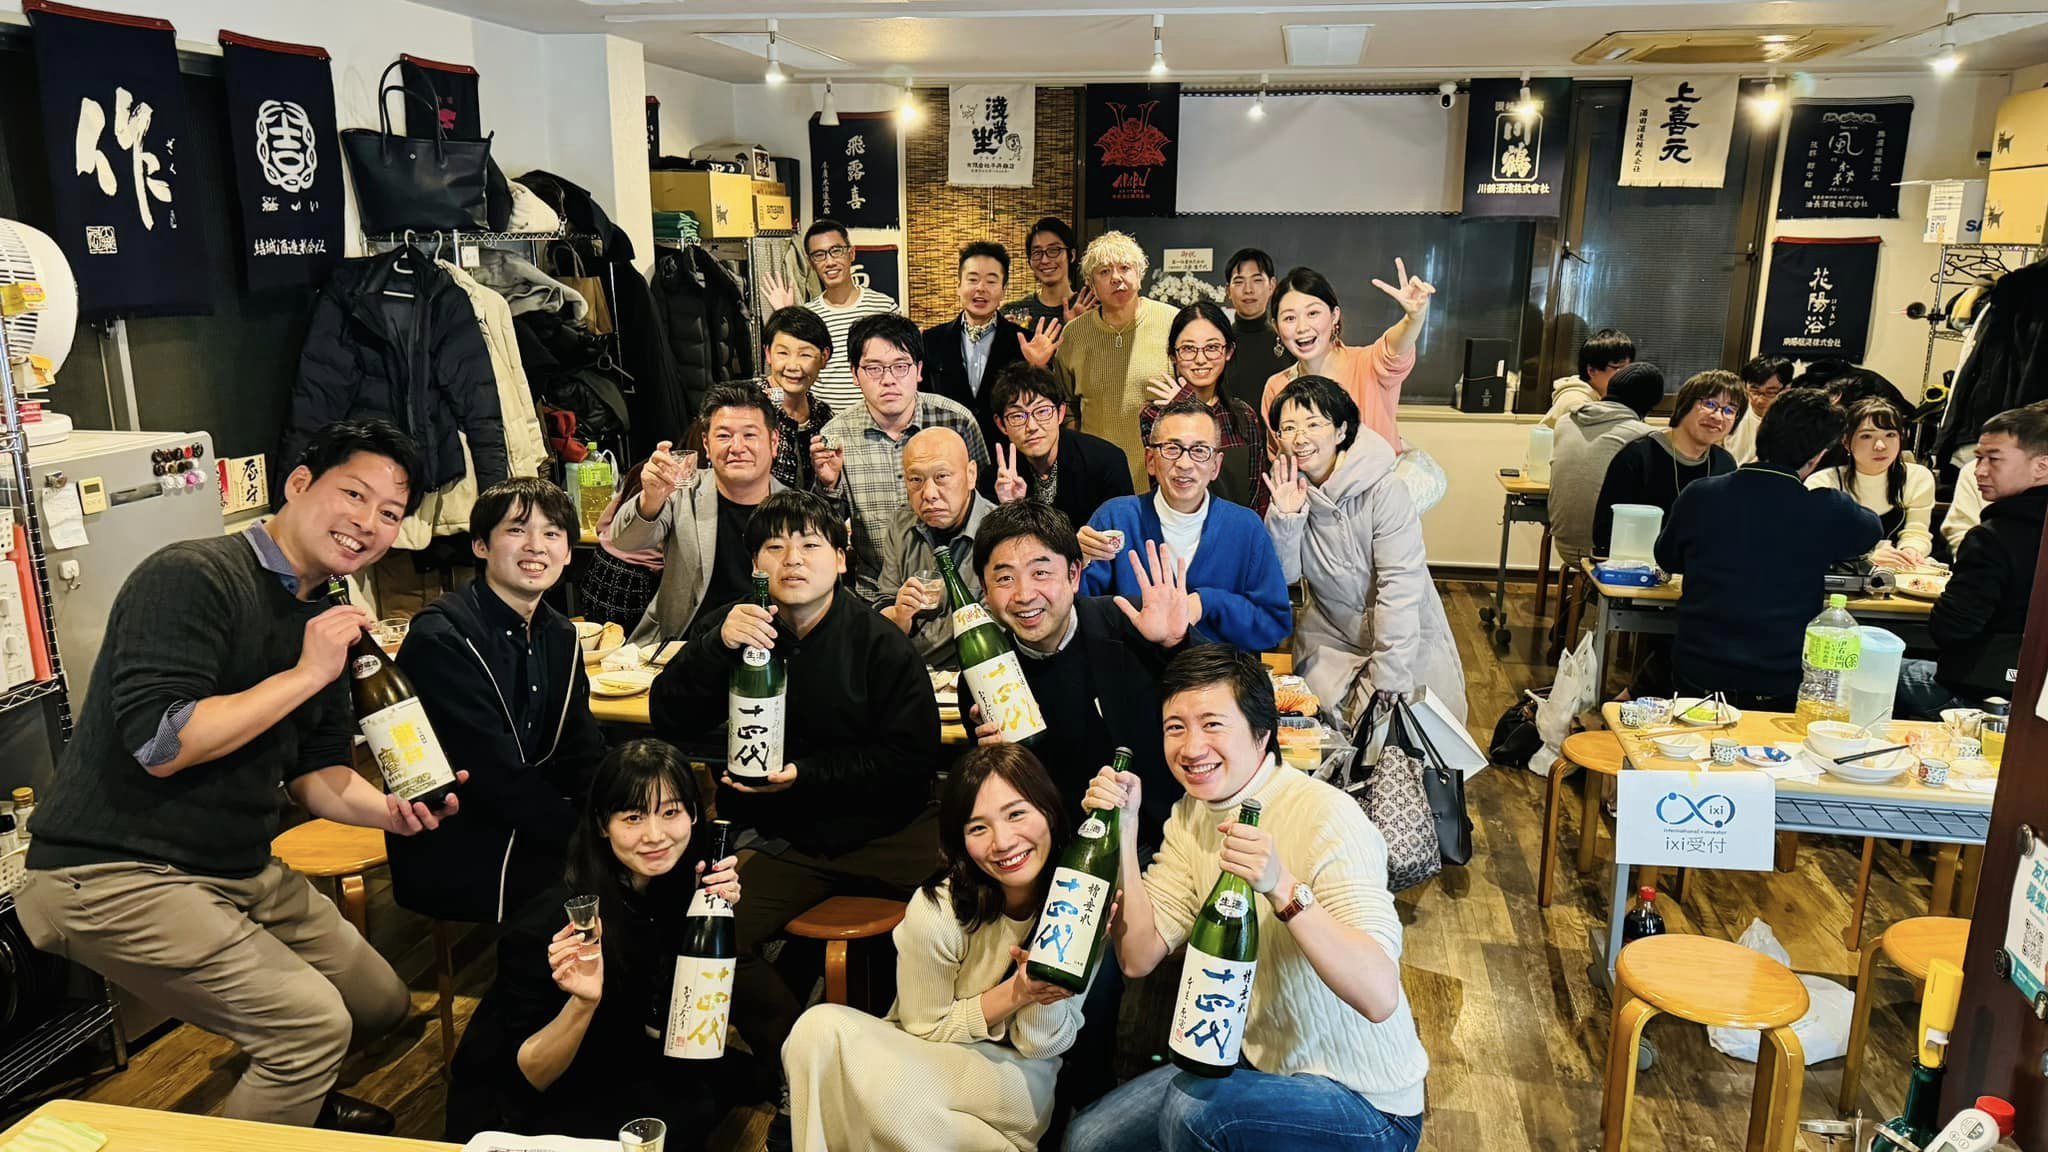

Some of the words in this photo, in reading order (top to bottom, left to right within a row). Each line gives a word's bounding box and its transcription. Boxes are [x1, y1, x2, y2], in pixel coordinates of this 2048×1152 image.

[1659, 81, 1702, 164] 上喜元
[76, 86, 172, 231] 作
[845, 134, 867, 211] 飛露喜
[1804, 267, 1833, 336] 花陽浴
[746, 650, 766, 660] 生酒
[983, 662, 1037, 731] 十四代
[734, 704, 768, 772] 十四代
[1709, 805, 1724, 815] ixi
[1666, 836, 1728, 854] ixi受付
[1035, 878, 1080, 962] 十四代
[1080, 883, 1101, 926] 槽垂れ
[688, 966, 729, 1051] 十四代
[1184, 968, 1236, 1059] 十四代
